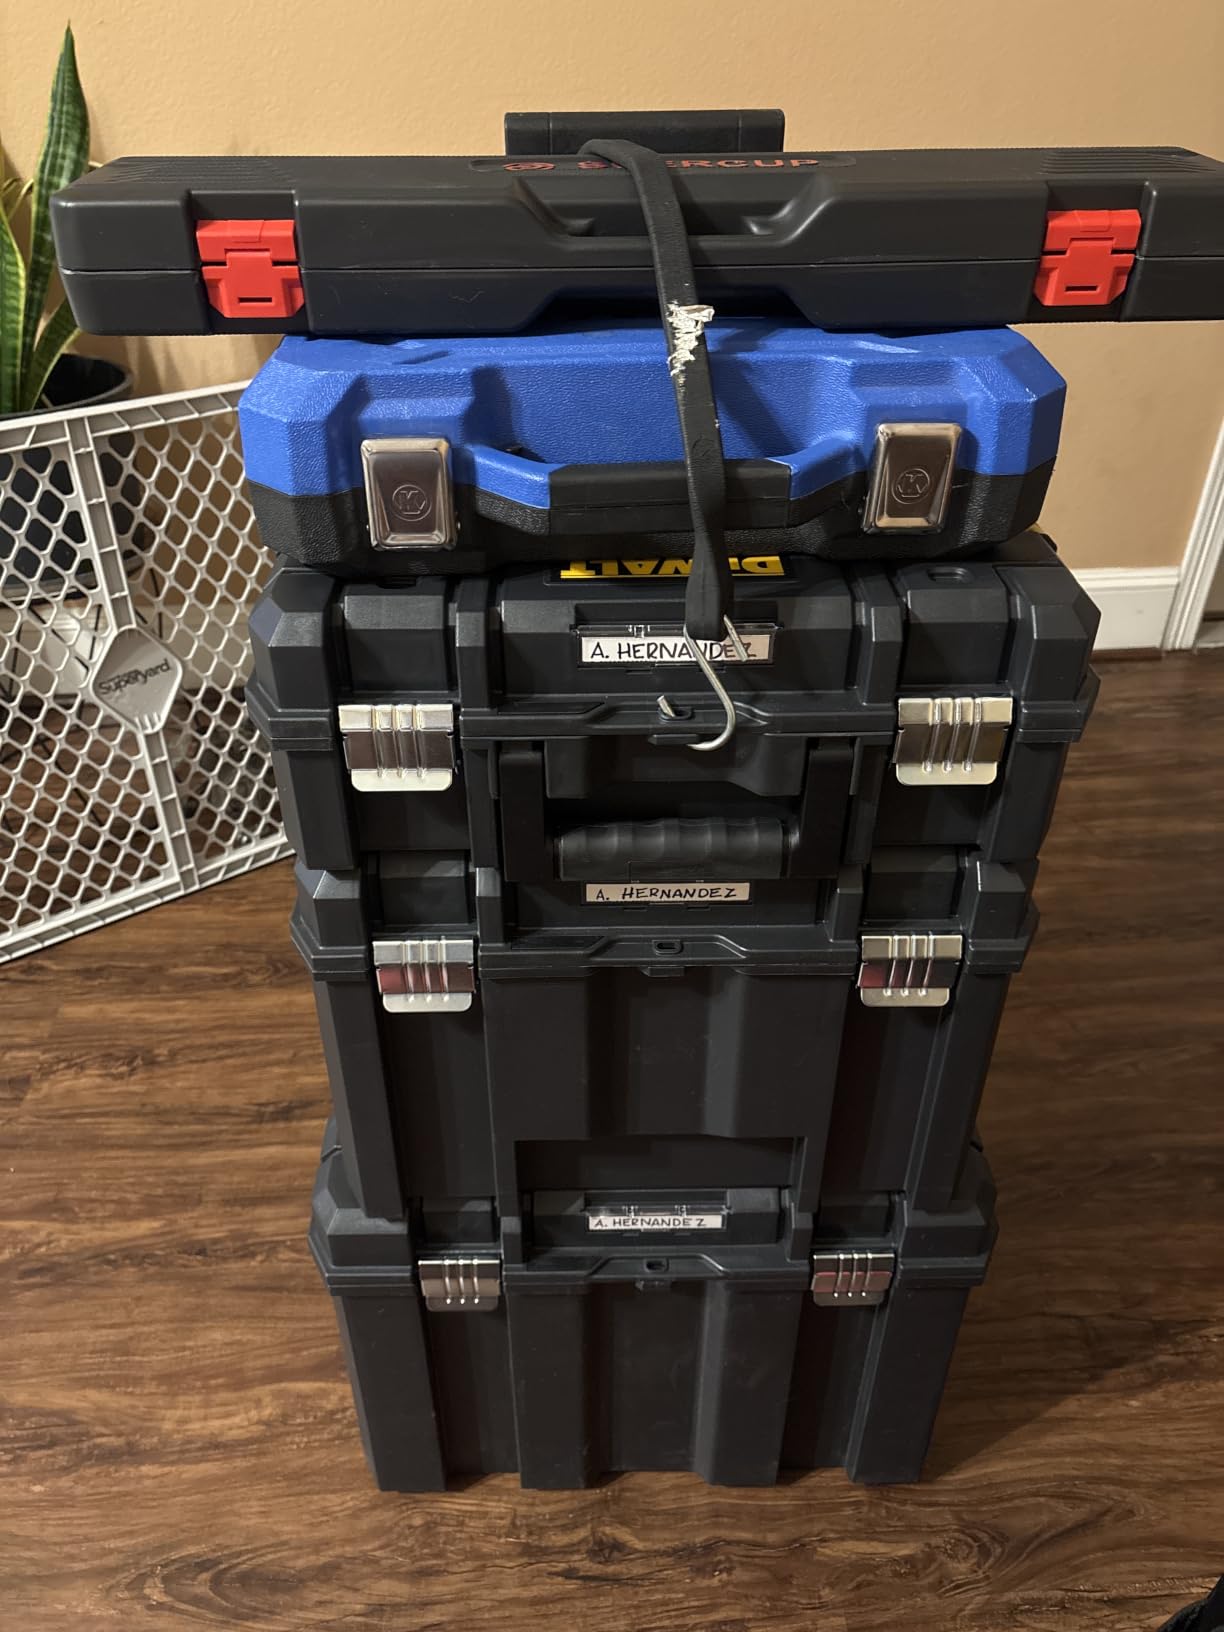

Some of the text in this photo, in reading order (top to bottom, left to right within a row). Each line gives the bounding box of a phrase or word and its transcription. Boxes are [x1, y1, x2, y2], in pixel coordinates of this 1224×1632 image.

[577, 159, 819, 169] SRCUP
[590, 641, 610, 660] A.
[595, 887, 737, 901] A. HERNANDEZ
[594, 1218, 608, 1228] A.
